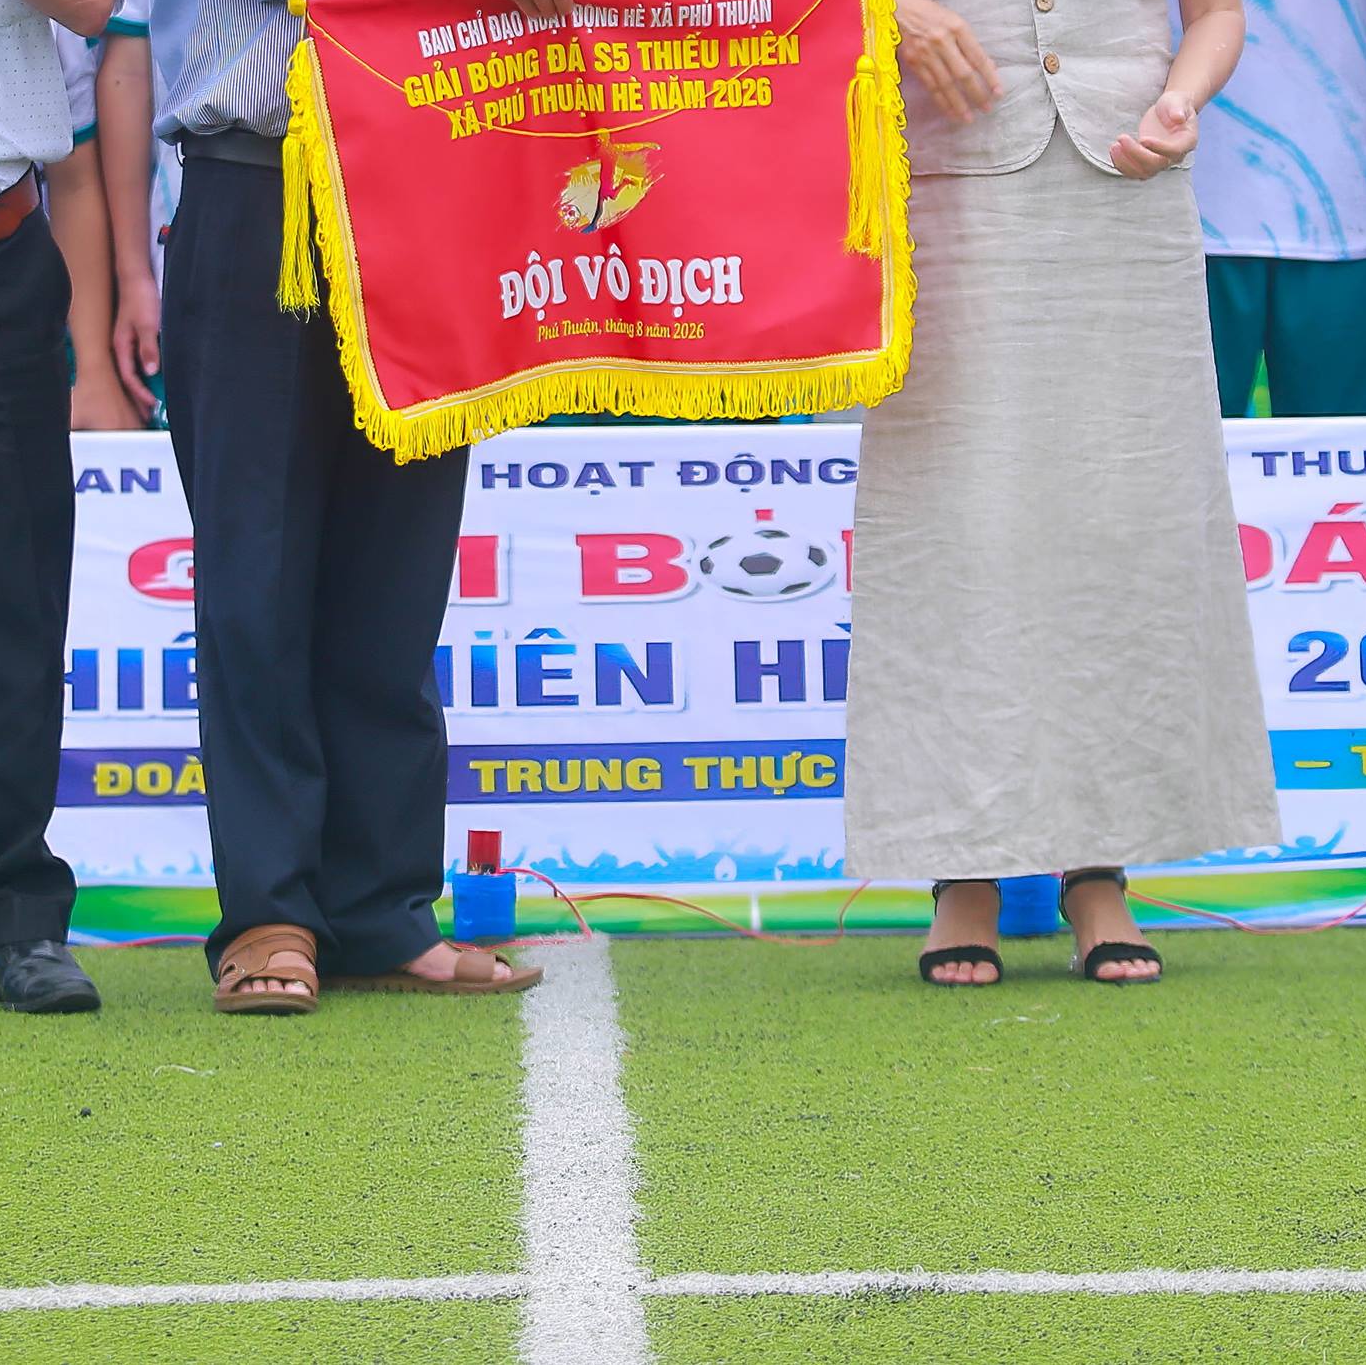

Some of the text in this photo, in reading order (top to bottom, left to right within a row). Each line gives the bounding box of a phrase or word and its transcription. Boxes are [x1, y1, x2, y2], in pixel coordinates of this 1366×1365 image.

[418, 25, 456, 58] BAN
[457, 10, 488, 50] CHỈ
[488, 10, 524, 46] ĐẠO
[623, 3, 646, 28] HÈ
[650, 2, 674, 28] XÃ
[403, 29, 801, 108] GIẢI BÓNG ĐÁ S5 THIẾU NIÊN
[447, 74, 773, 140] XÃ PHÚ THUẬN HÈ NĂM 2026
[500, 243, 744, 322] ĐỘI VÔ ĐỊCH
[538, 323, 559, 343] Phú
[605, 318, 635, 338] tháng
[636, 321, 643, 336] 8
[646, 322, 671, 339] năm
[673, 322, 705, 339] 2026
[75, 467, 163, 494] AN
[481, 461, 656, 495] HOẠT
[676, 453, 858, 493] ĐỘNG
[436, 626, 674, 707] IÊN
[93, 755, 207, 797] ĐOÀ
[469, 757, 662, 794] TRUNG
[683, 751, 837, 795] THỰC
